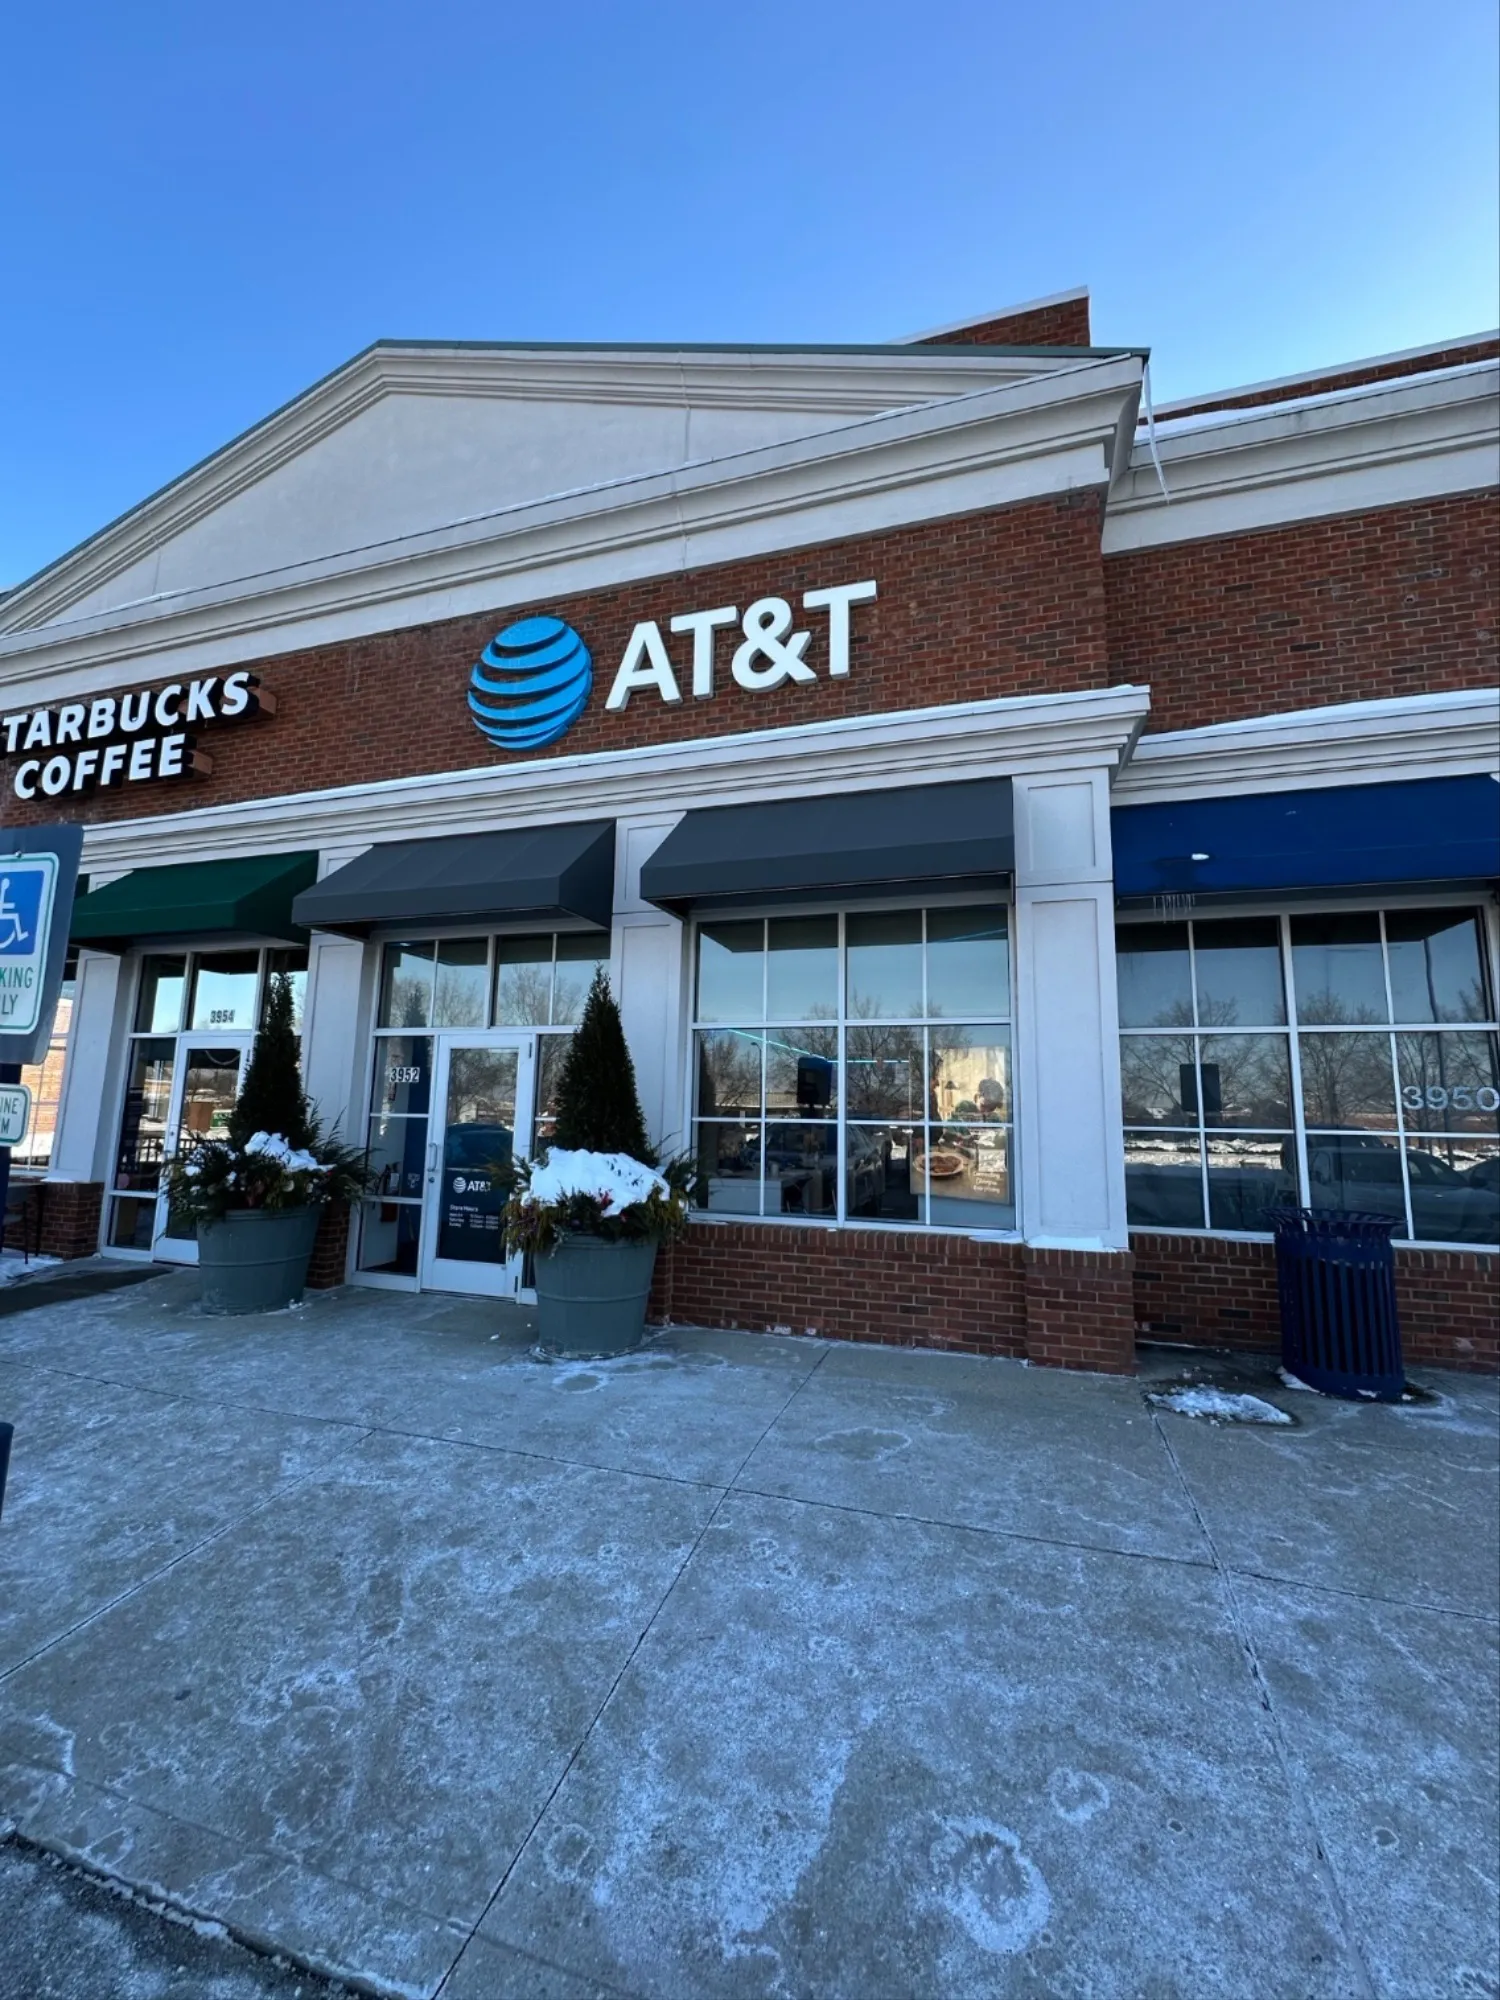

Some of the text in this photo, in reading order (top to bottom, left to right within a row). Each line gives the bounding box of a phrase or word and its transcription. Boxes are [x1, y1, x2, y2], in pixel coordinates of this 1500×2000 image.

[605, 580, 877, 712] AT&T
[2, 671, 250, 752] TARBUCKS
[14, 733, 186, 800] COFFEE
[0, 994, 18, 1015] LY
[390, 1067, 419, 1082] 3952
[1402, 1085, 1500, 1111] 3950
